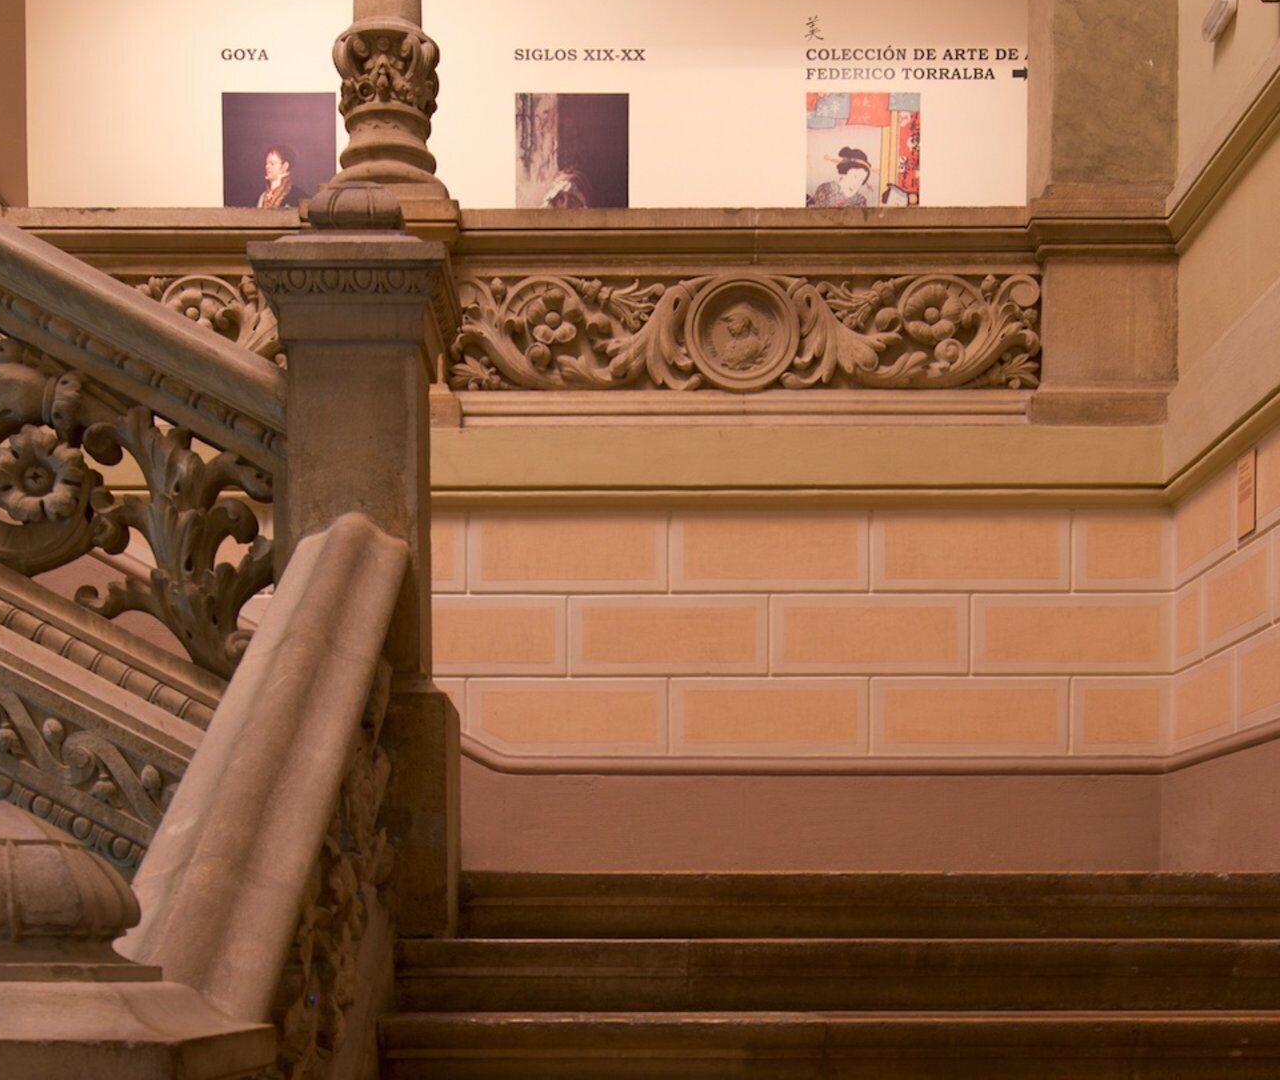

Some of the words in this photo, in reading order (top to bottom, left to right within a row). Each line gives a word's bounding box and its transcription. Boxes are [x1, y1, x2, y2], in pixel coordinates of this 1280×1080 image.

[221, 48, 269, 62] GOYA
[514, 48, 578, 62] SIGLOS
[583, 48, 646, 62] XIX-XX
[806, 45, 908, 61] COLECCIÓN
[914, 48, 937, 61] DE
[942, 48, 989, 61] ARTE
[996, 48, 1020, 61] DE
[806, 68, 896, 81] FEDERICO
[901, 68, 995, 81] TORRALBA
